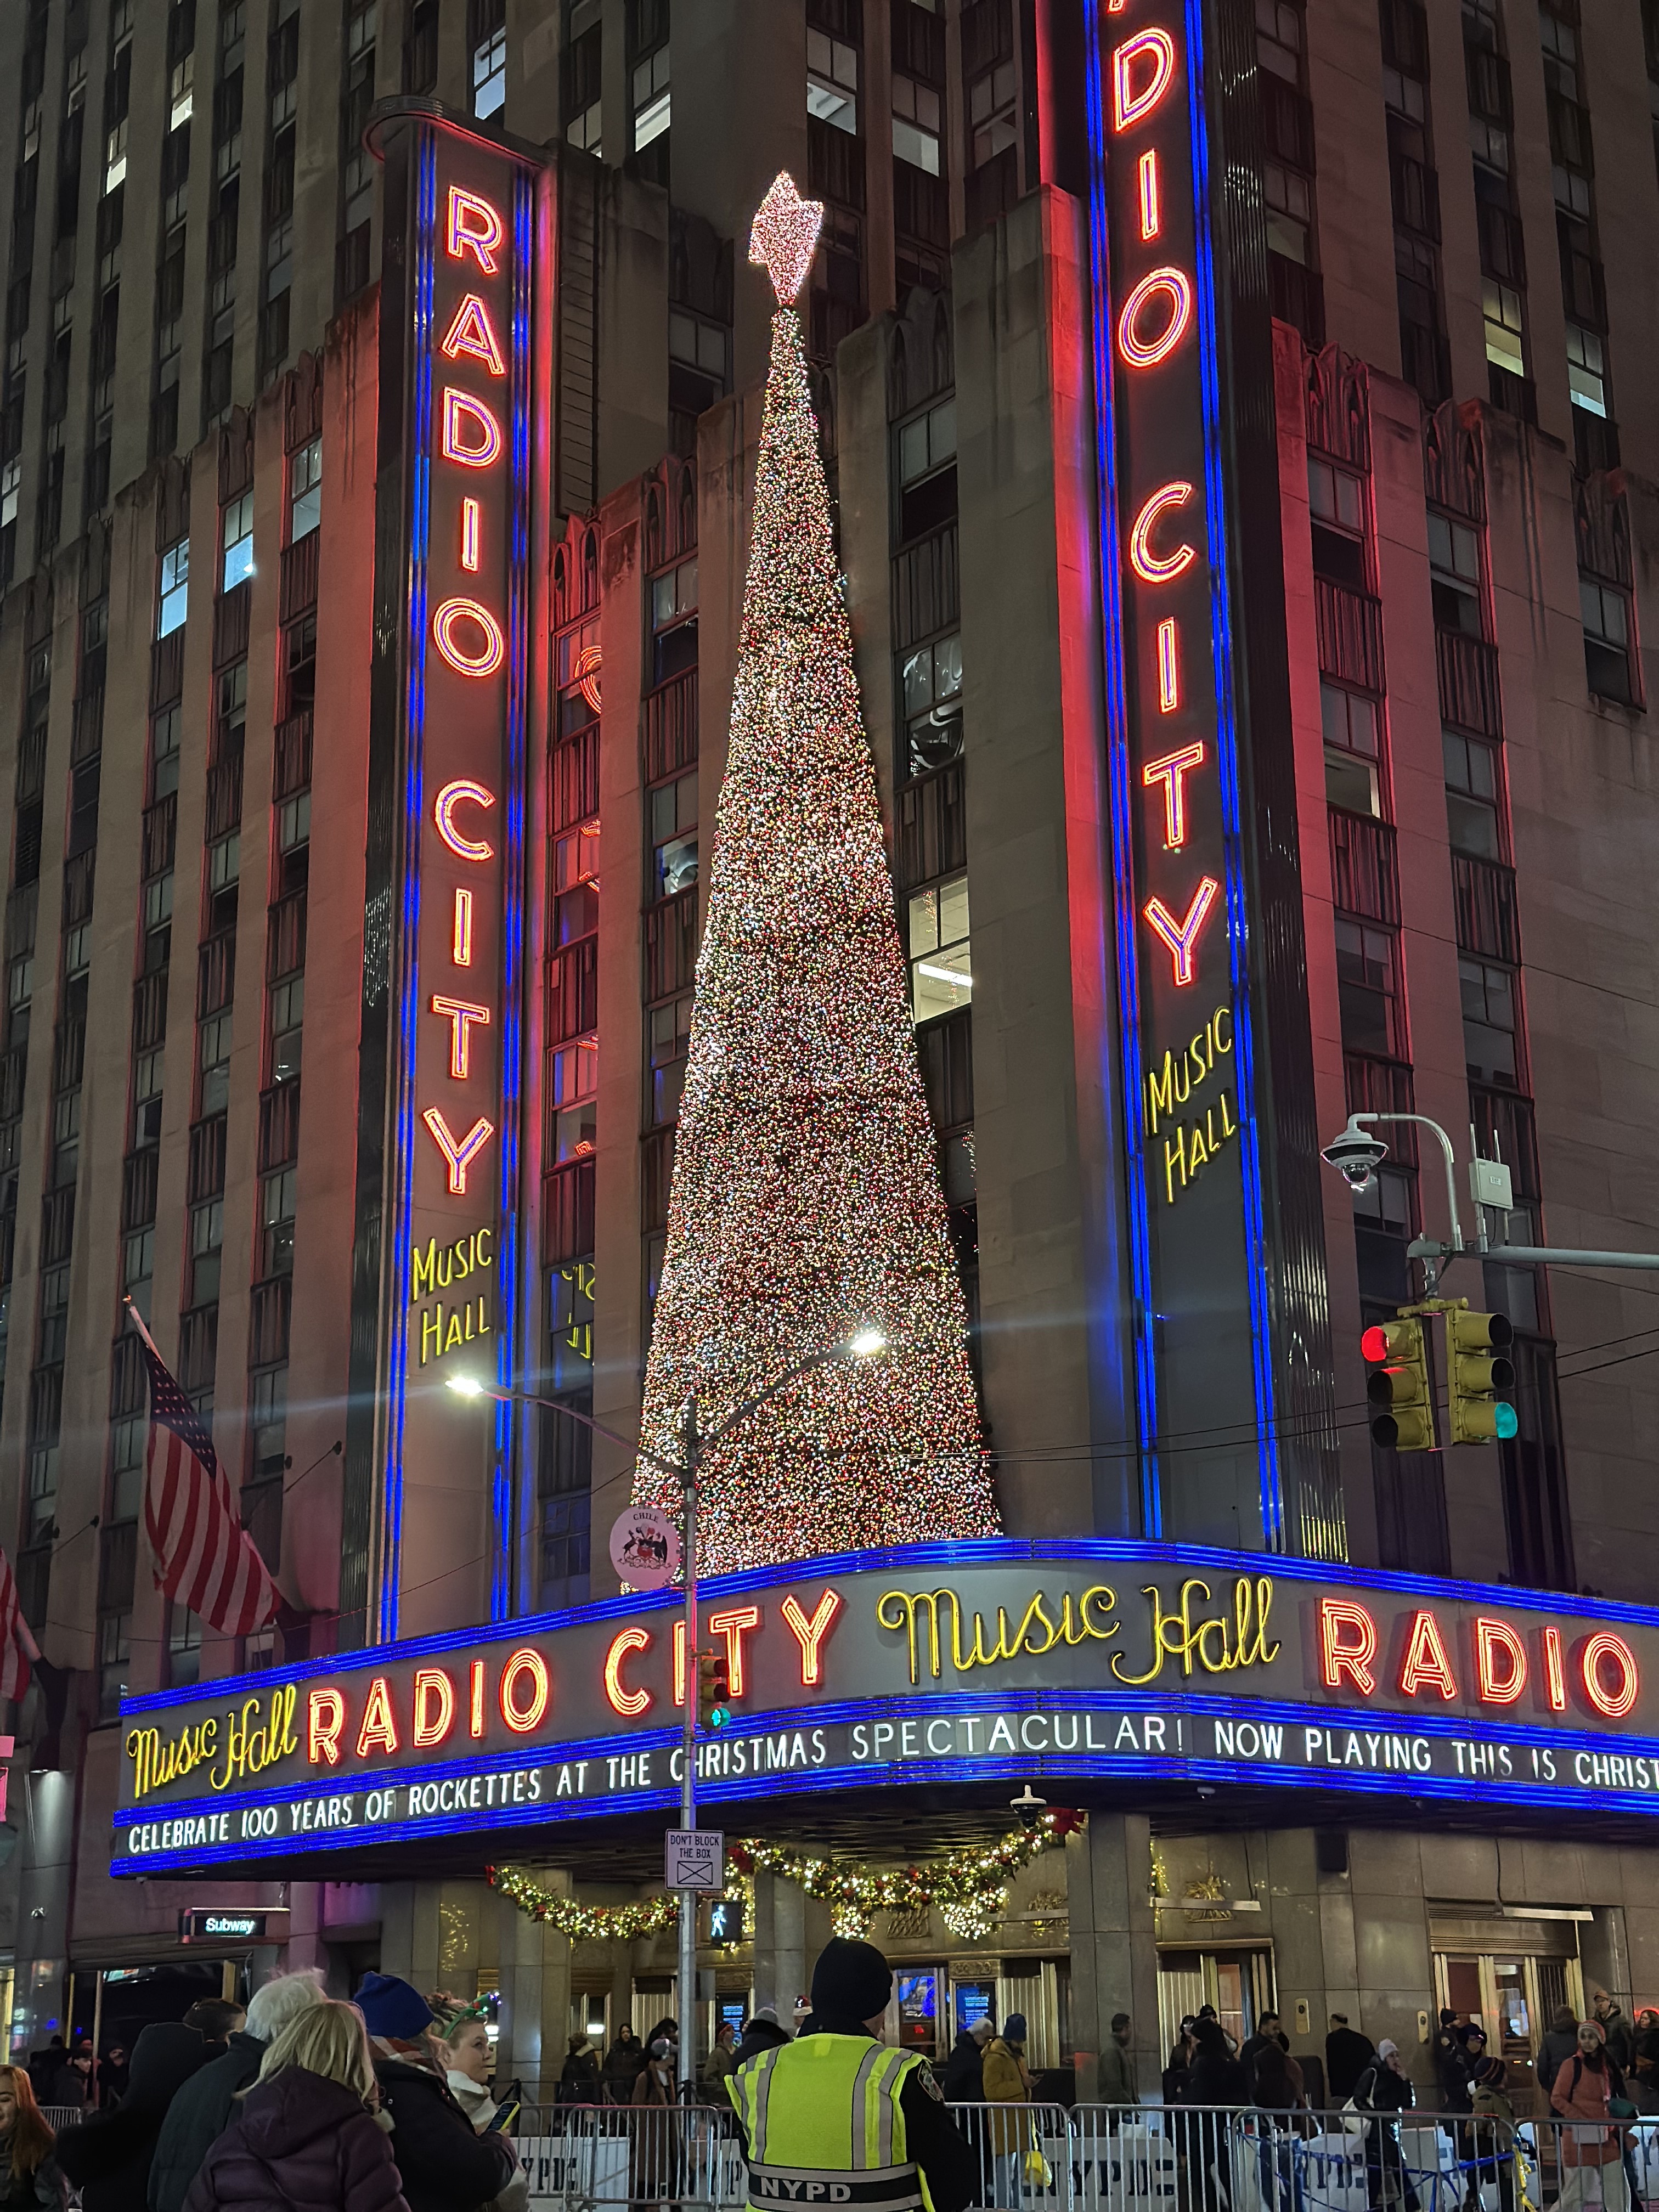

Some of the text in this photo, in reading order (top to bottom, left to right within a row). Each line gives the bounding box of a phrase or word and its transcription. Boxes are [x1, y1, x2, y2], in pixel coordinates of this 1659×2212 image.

[1107, 0, 1218, 986] DIO CITY
[422, 185, 505, 1195] RADIO CITY
[1149, 1006, 1232, 1134] MUSIC
[1165, 1092, 1236, 1204] HALL
[412, 1228, 492, 1301] MUSIC
[421, 1296, 490, 1364] HALL
[633, 1513, 658, 1523] CHILE
[126, 1576, 1639, 1799] Music Hall RADIO CITY Music Hall RADIO
[128, 1814, 230, 1853] CELEBRATE
[242, 1809, 278, 1838] 100
[290, 1796, 353, 1831] YEARS
[366, 1790, 394, 1822] OF
[409, 1769, 540, 1815] ROCKETTES
[556, 1762, 588, 1796] AT
[607, 1753, 651, 1789] THE
[670, 1730, 826, 1781] CHRISTMAS
[852, 1714, 1182, 1759] SPECTACULAR!
[1216, 1722, 1283, 1759] NOW
[1305, 1728, 1431, 1772] PLAYING
[1452, 1741, 1513, 1777] THIS
[1532, 1748, 1557, 1780] IS
[670, 1835, 720, 1846] DON'T BLOCK
[680, 1848, 710, 1858] THE BOX
[206, 1917, 255, 1934] Subway
[760, 2176, 851, 2202] NYPD
